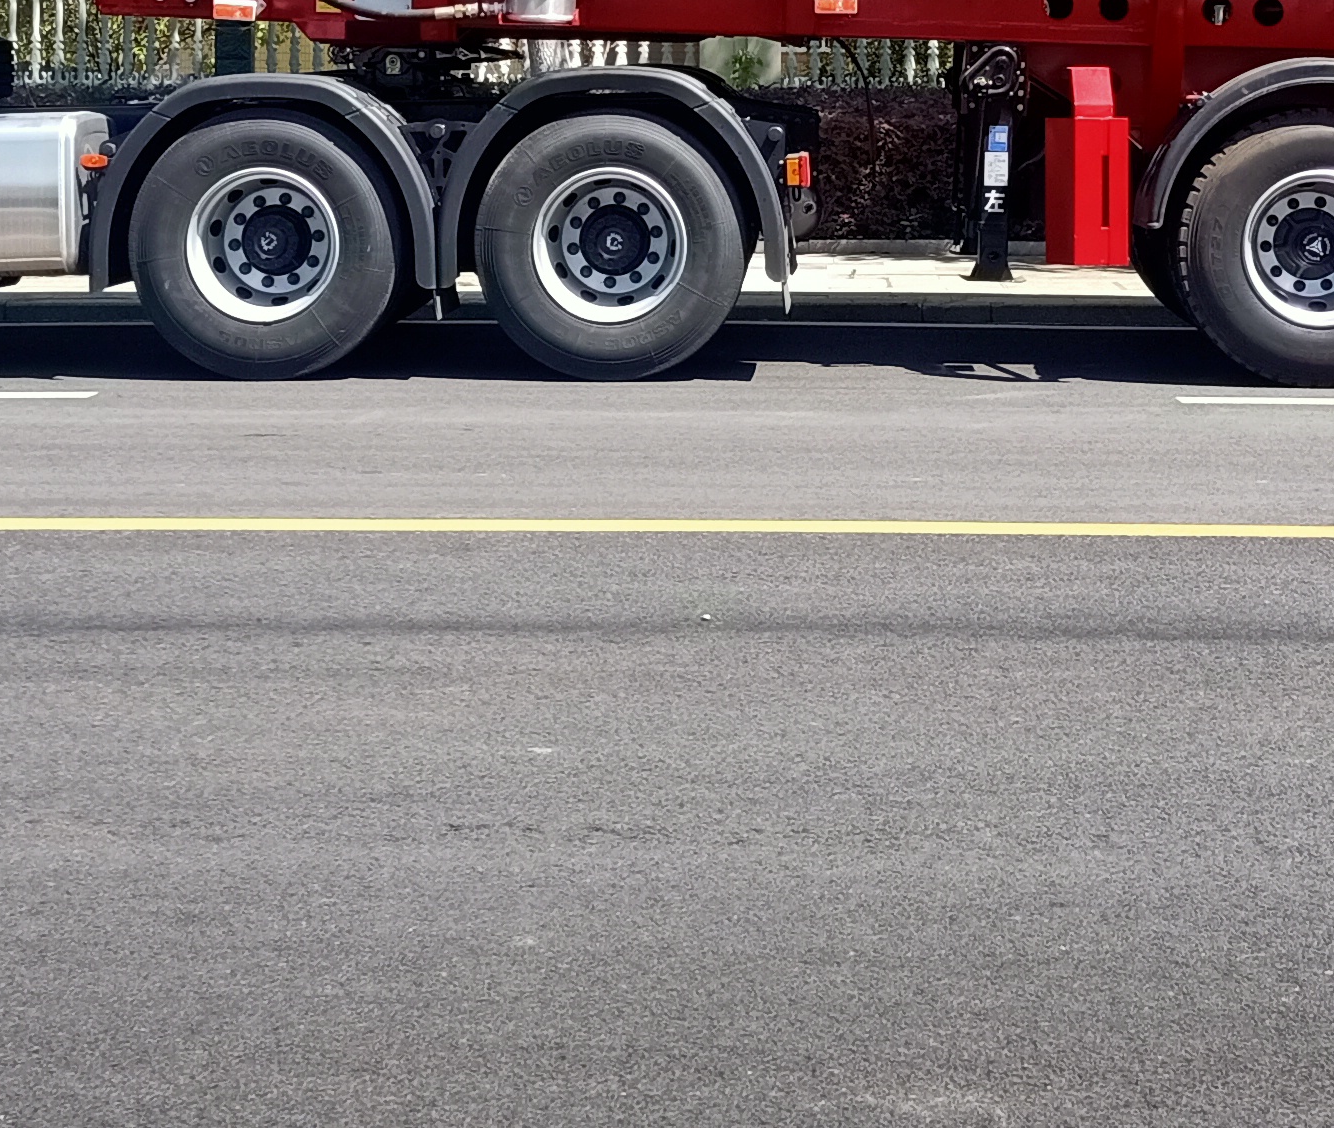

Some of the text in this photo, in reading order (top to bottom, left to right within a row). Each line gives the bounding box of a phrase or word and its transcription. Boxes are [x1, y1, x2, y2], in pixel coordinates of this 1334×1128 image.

[220, 139, 336, 180] AEOLUS
[531, 139, 645, 188] AEOLUS
[984, 189, 1006, 213] 左
